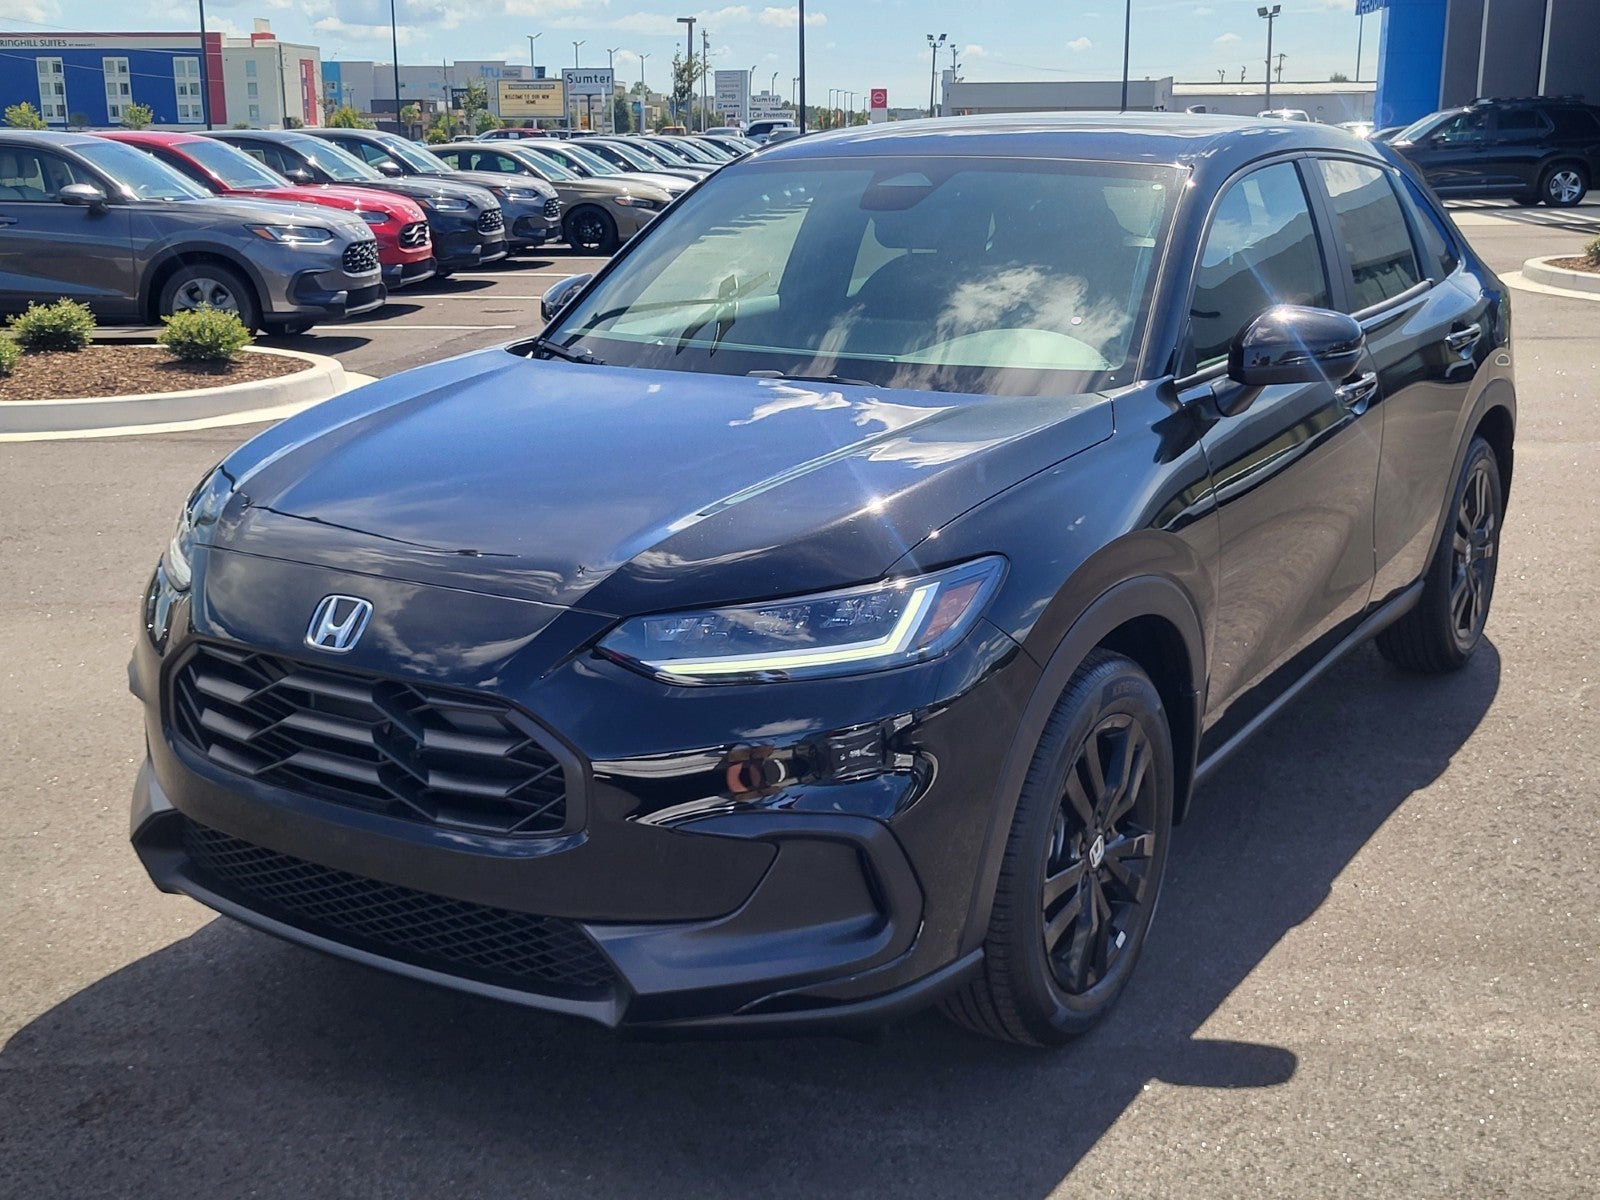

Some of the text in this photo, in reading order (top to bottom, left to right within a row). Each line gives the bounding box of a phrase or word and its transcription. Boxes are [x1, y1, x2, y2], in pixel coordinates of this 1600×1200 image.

[39, 39, 67, 47] SUITES
[480, 65, 500, 78] tru
[566, 73, 611, 84] Sumter
[719, 92, 737, 101] Jeep
[763, 111, 793, 119] Inventory
